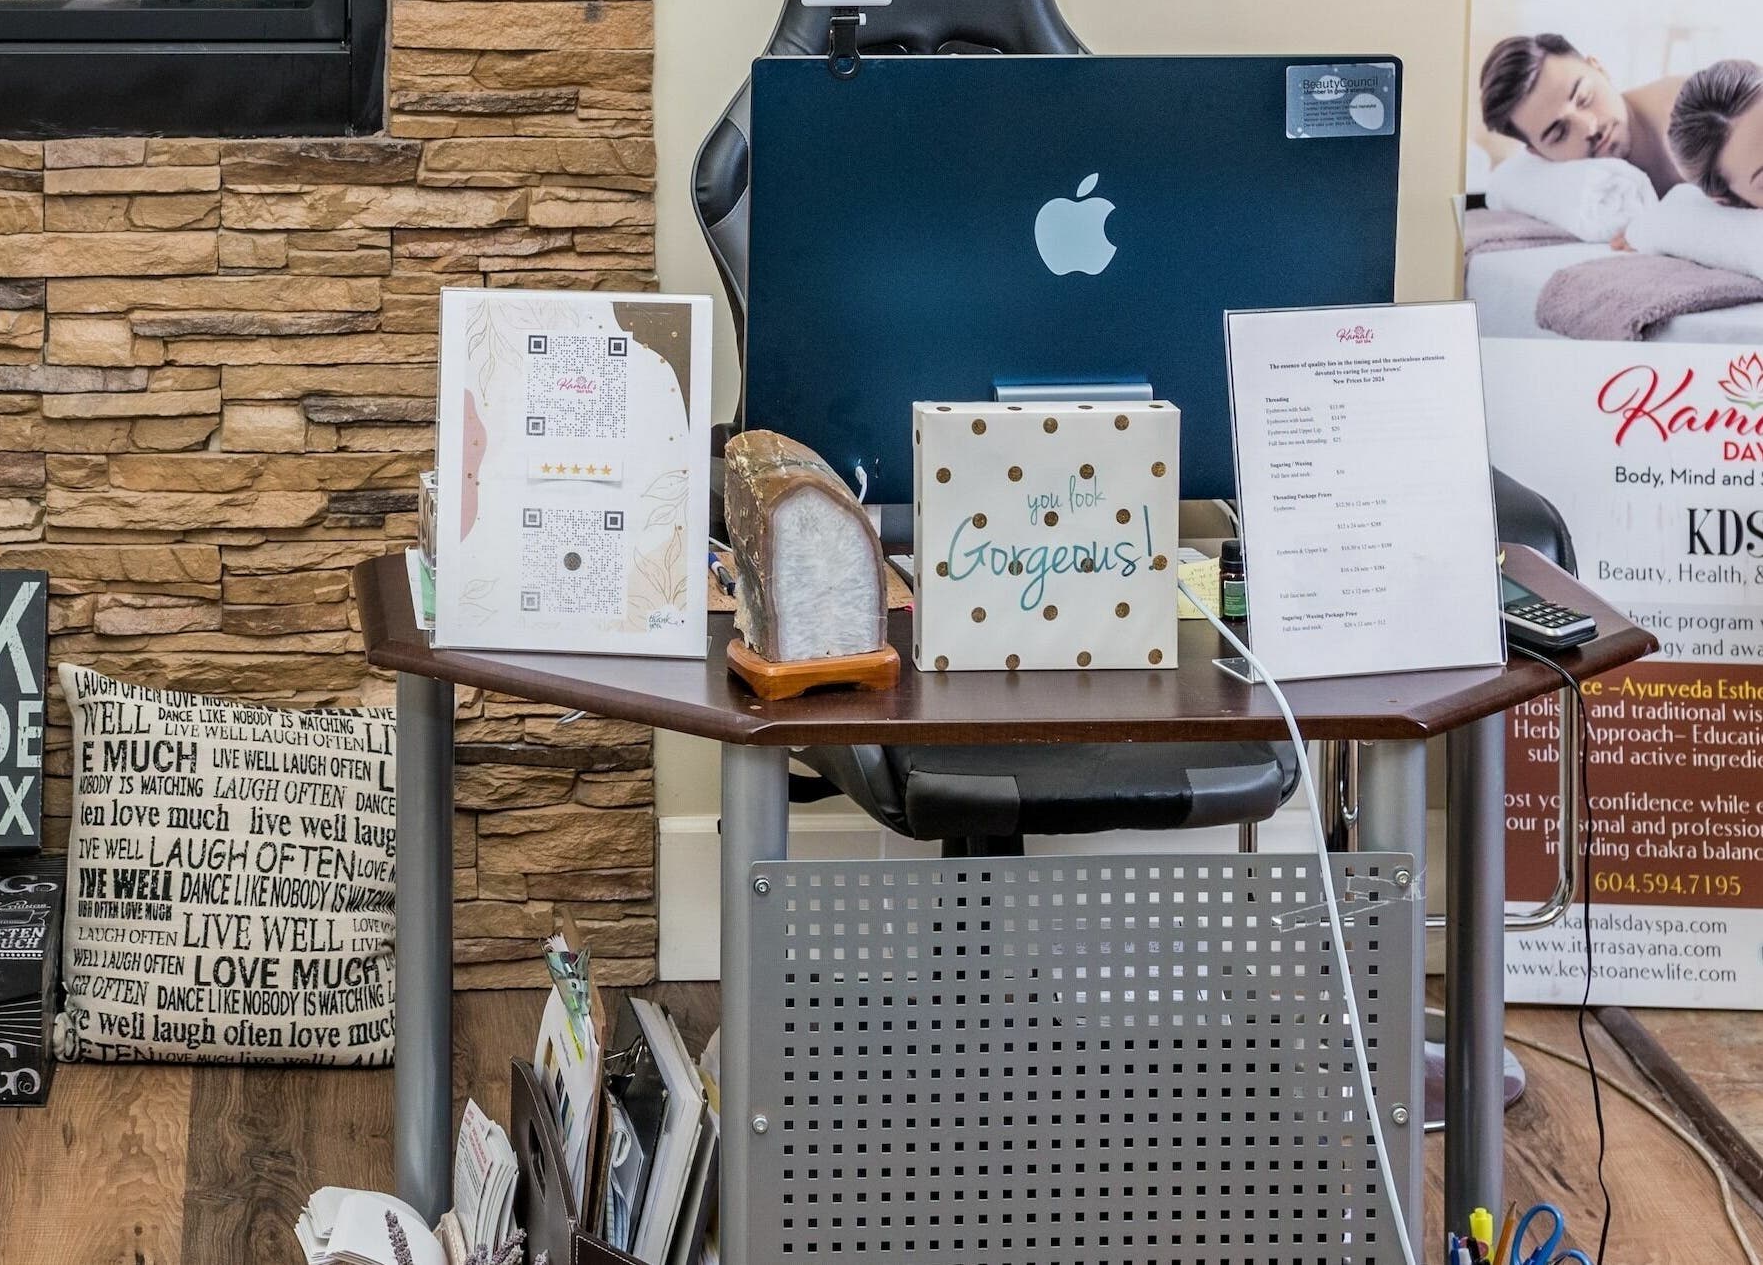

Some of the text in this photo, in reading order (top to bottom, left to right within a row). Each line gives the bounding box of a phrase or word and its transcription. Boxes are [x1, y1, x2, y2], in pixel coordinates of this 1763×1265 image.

[1303, 77, 1378, 89] BeautyCouncil
[1615, 466, 1755, 488] Body, Mind and
[1027, 475, 1106, 526] you look
[947, 505, 1155, 611] Gorgeous!
[1598, 560, 1747, 585] Beauty, Health,
[1678, 614, 1754, 634] program
[1692, 638, 1724, 657] and
[1591, 699, 1625, 719] and
[1631, 700, 1726, 723] traditional
[103, 740, 198, 774] MUCH
[1590, 746, 1624, 765] and
[1630, 746, 1687, 766] active
[213, 776, 280, 802] LAUGH
[1588, 791, 1694, 813] confidence
[1700, 794, 1751, 814] while
[1631, 815, 1666, 835] and
[1672, 816, 1763, 840] professio
[148, 836, 357, 882] LAUGH OFTEN
[1636, 838, 1697, 859] chakra
[1595, 871, 1742, 896] 604.594.7195
[183, 911, 344, 953] LIVE WELL
[1519, 936, 1721, 958] www.itrrasayana.com
[194, 955, 280, 989] LOVE
[153, 1013, 284, 1050] laugh often
